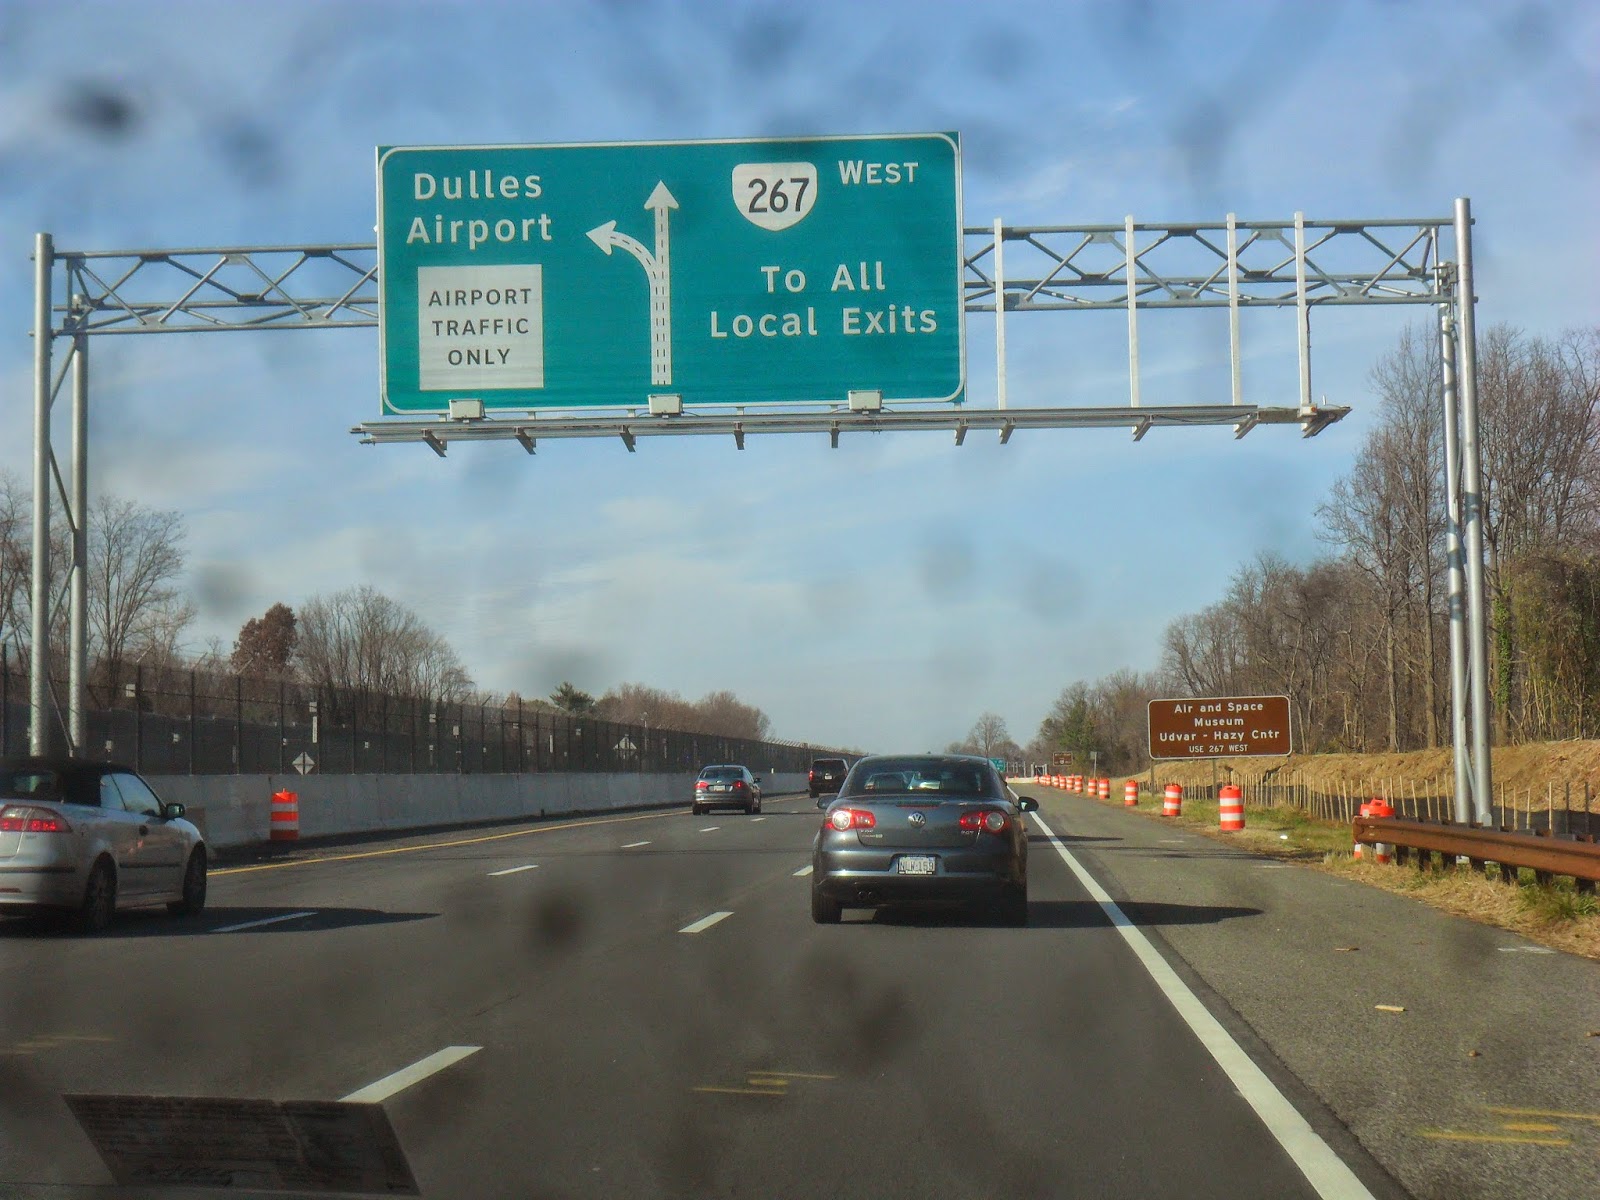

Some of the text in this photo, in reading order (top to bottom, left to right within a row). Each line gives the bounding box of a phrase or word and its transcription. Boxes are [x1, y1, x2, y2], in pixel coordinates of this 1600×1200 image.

[414, 169, 542, 200] Dulles
[748, 160, 919, 213] 267 WEST
[406, 213, 552, 250] Airport
[760, 261, 886, 293] To All
[428, 288, 532, 307] AIRPORT
[431, 317, 530, 336] TRAFFIC
[710, 304, 938, 338] Local Exits
[447, 348, 511, 366] ONLY
[1174, 702, 1264, 714] Air and Space
[1194, 718, 1244, 727] Museum
[1159, 732, 1197, 742] Udvar
[1214, 731, 1245, 742] Hazy
[1251, 729, 1280, 739] Cntr
[1188, 744, 1249, 753] USE 267 WEST
